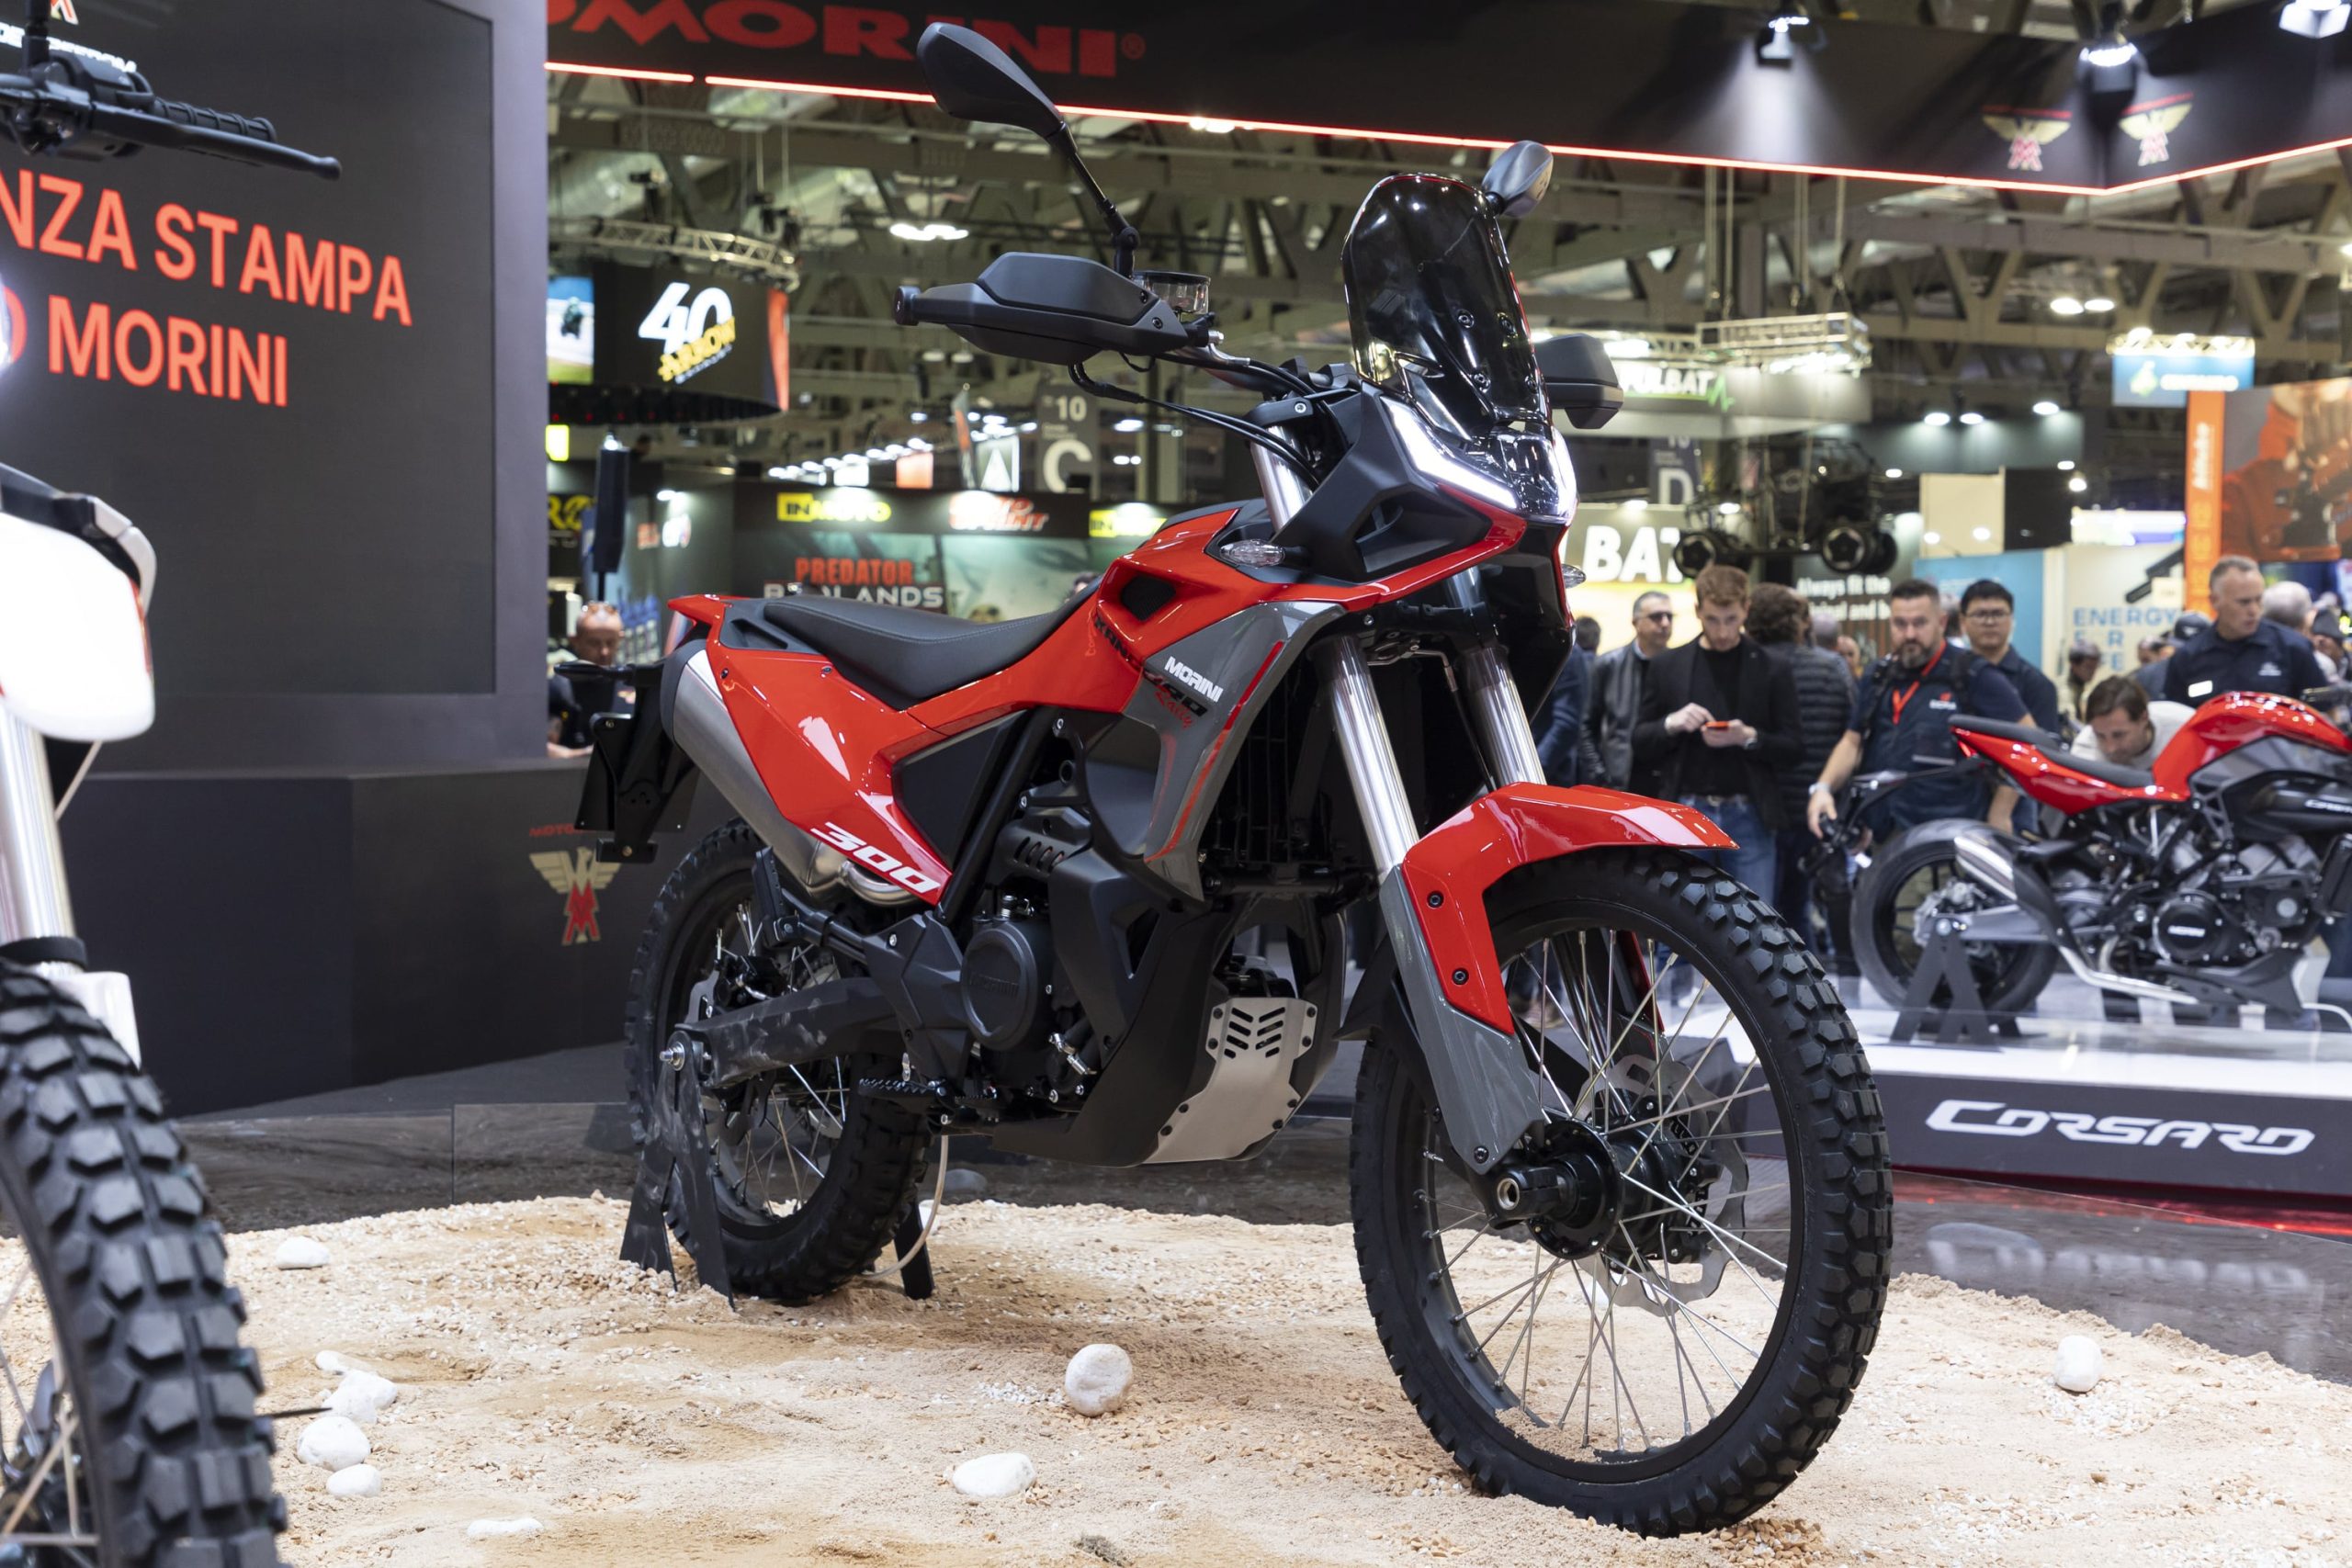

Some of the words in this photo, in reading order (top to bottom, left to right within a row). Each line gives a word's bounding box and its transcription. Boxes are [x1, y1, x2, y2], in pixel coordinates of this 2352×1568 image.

[571, 0, 1116, 77] MORNI
[154, 203, 413, 326] STAMPA
[639, 281, 733, 356] 40
[48, 295, 288, 407] MORINI
[1057, 395, 1087, 422] 10
[1043, 439, 1092, 493] C
[1658, 468, 1694, 504] D
[763, 582, 944, 608] BLANDS
[796, 558, 913, 585] PREDATOR
[2073, 607, 2177, 626] ENERGY
[1164, 656, 1224, 703] MORINI
[810, 821, 941, 894] 300
[1925, 1100, 2315, 1156] CORSARO
